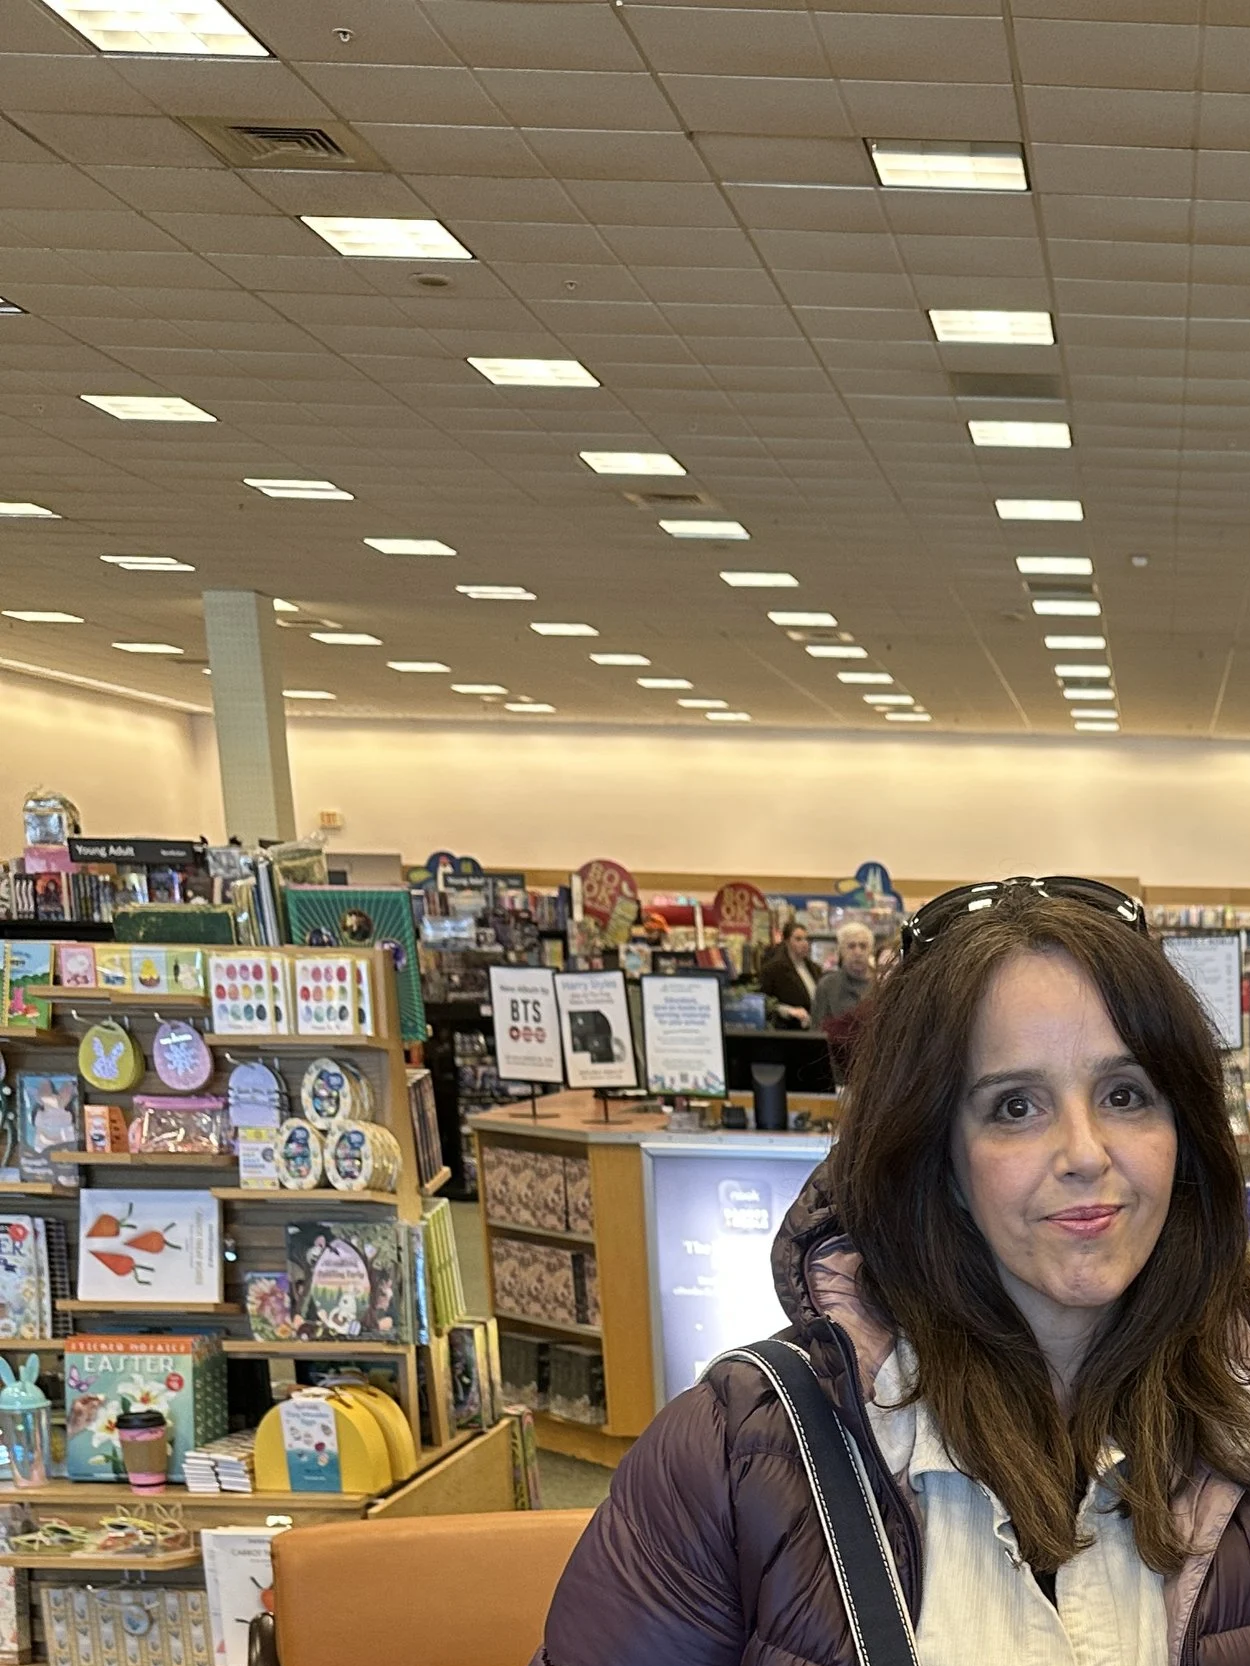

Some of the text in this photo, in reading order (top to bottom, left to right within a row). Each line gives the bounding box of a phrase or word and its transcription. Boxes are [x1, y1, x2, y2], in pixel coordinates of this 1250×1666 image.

[75, 844, 135, 858] Young Adult
[510, 999, 541, 1023] BTS
[84, 1355, 174, 1373] EASTER
